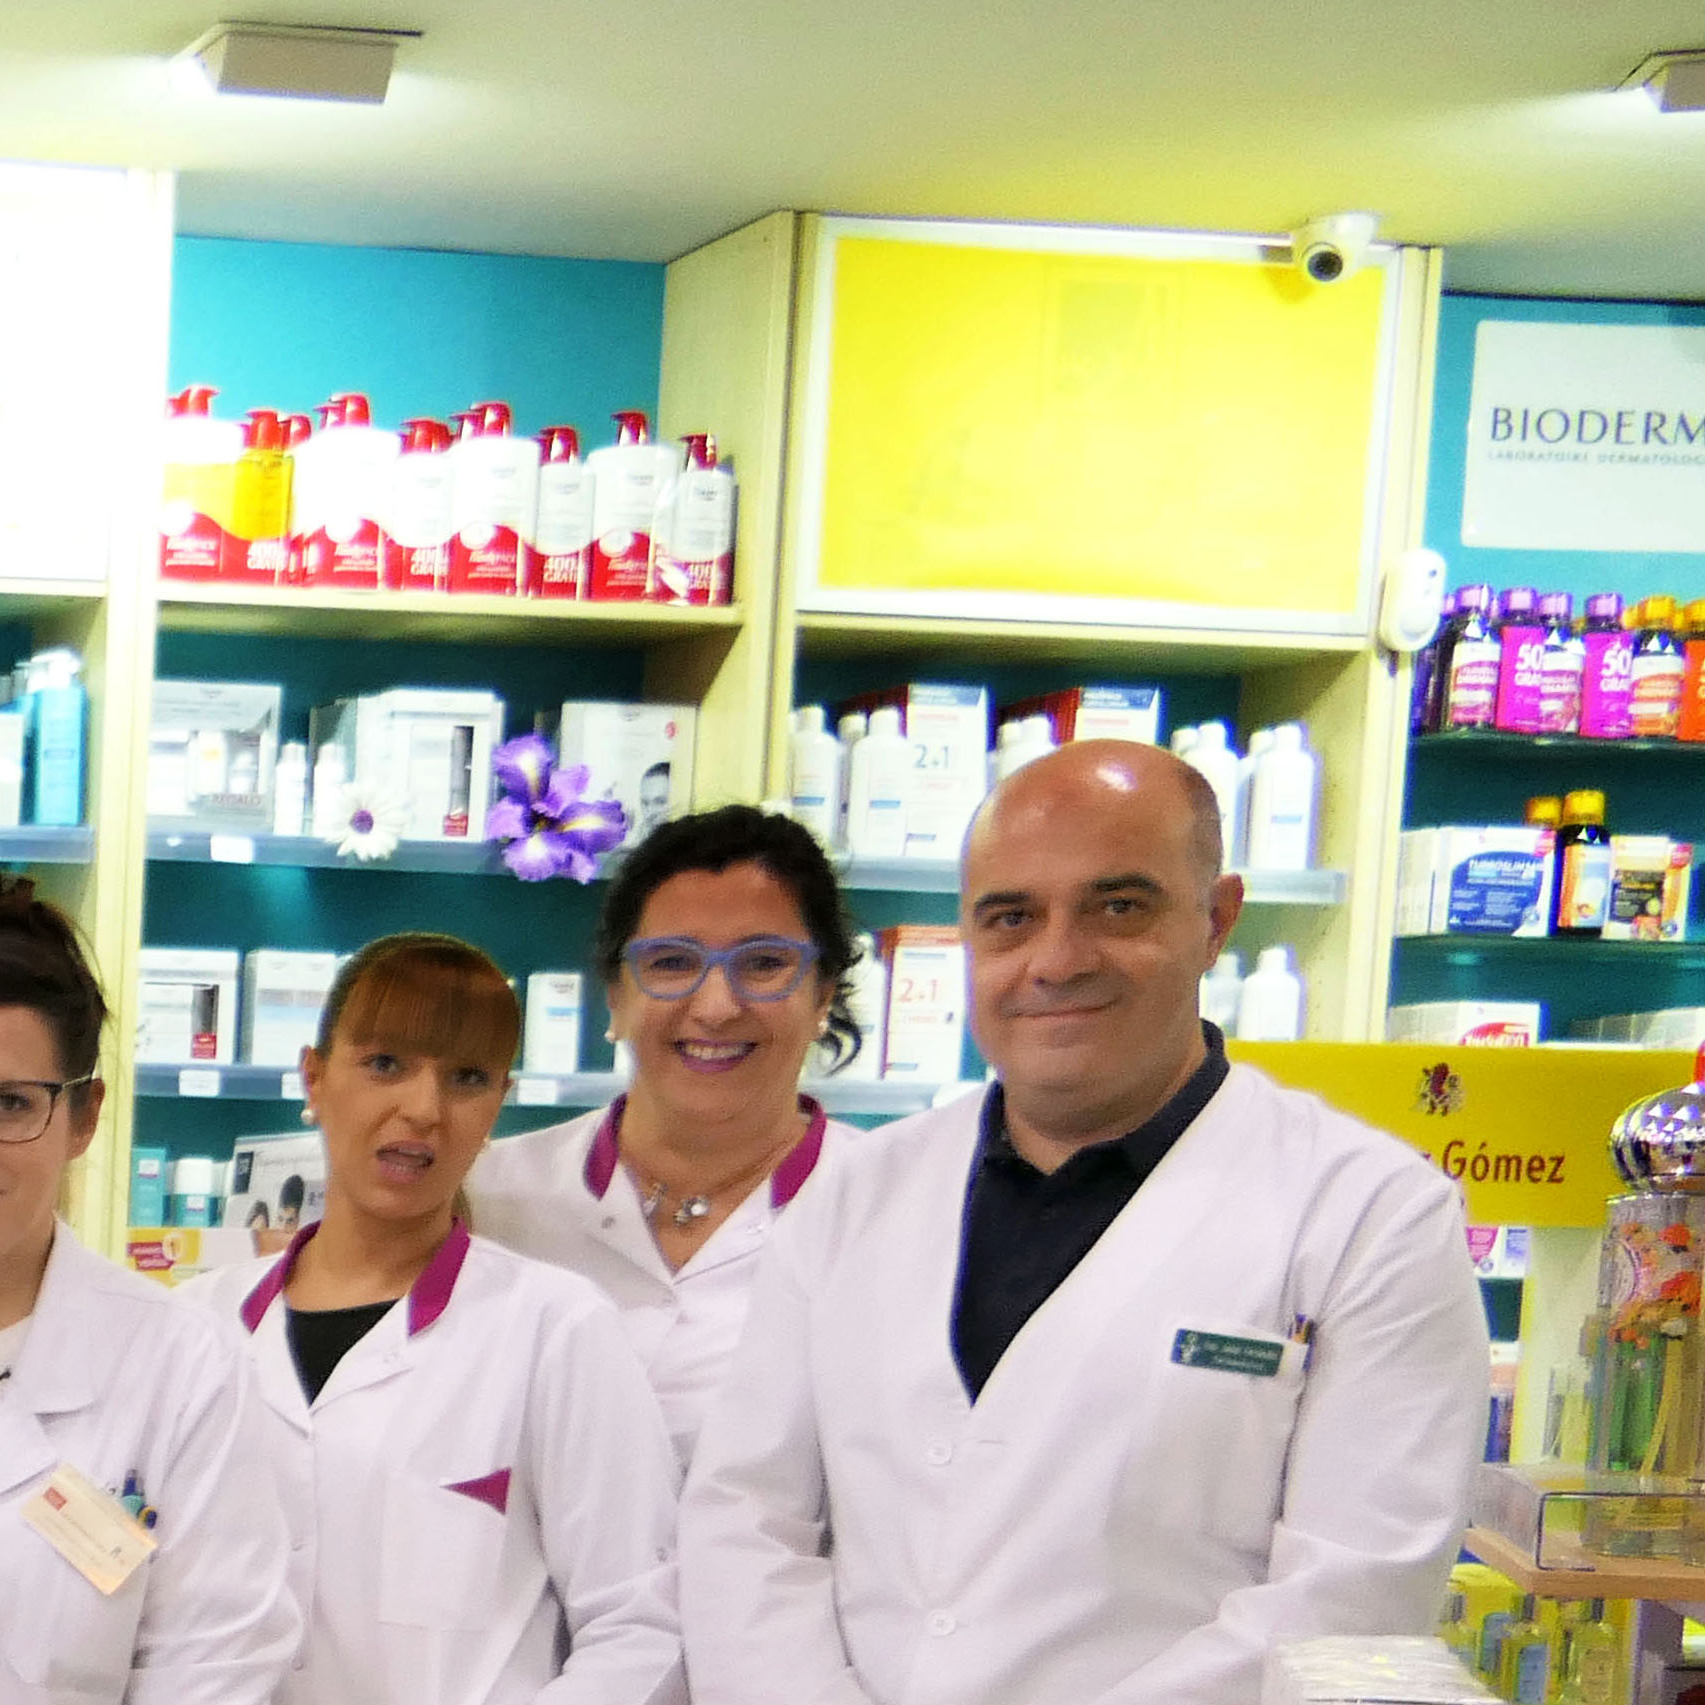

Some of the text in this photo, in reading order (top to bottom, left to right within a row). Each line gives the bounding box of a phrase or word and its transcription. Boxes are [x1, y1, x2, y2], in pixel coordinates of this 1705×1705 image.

[1515, 643, 1544, 671] 50
[1600, 649, 1632, 677] 50
[1442, 1140, 1566, 1184] Gómez
